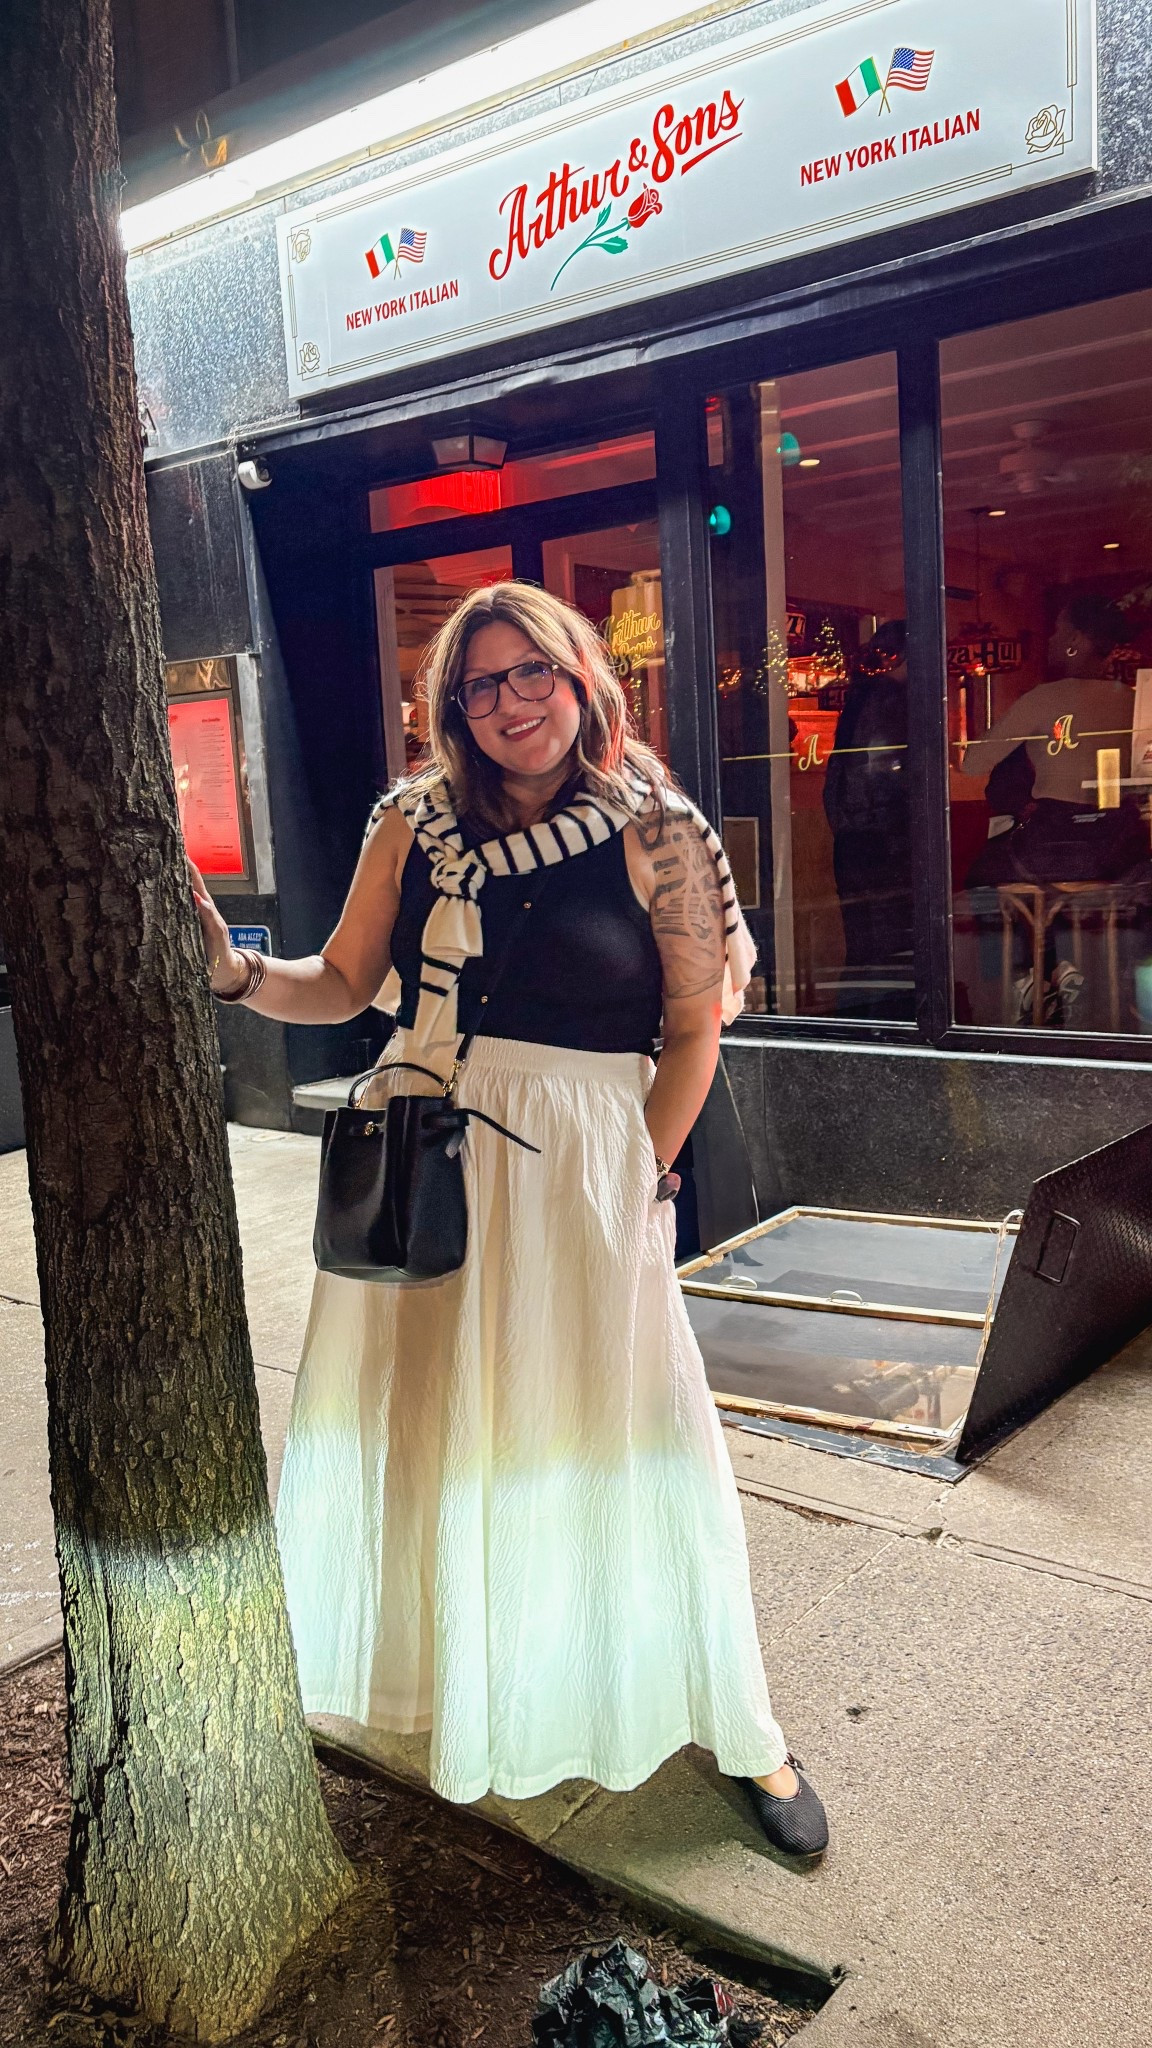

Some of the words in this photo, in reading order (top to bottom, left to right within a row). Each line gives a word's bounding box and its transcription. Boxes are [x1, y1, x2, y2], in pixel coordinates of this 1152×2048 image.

[800, 153, 842, 187] NEW
[845, 136, 896, 173] YORK
[901, 108, 981, 156] ITALIAN
[488, 159, 631, 281] Arthur
[628, 137, 649, 173] &
[651, 89, 745, 184] Sons
[345, 308, 373, 332] NEW
[374, 292, 408, 319] YORK
[409, 280, 460, 314] ITALIAN
[798, 734, 824, 771] A
[1047, 714, 1079, 756] A
